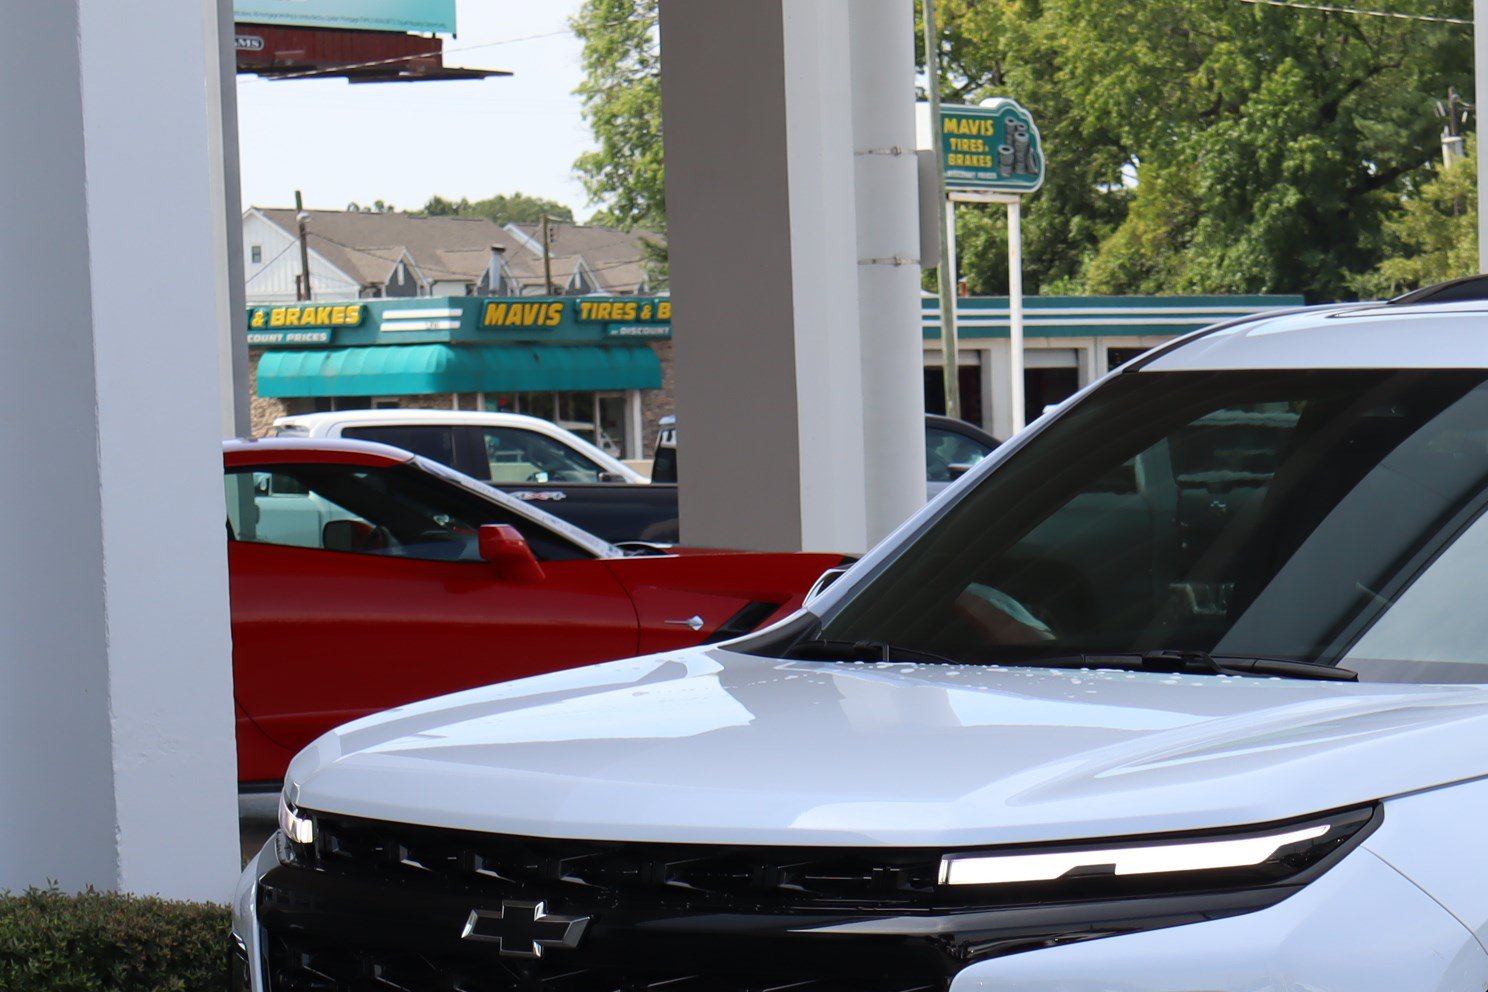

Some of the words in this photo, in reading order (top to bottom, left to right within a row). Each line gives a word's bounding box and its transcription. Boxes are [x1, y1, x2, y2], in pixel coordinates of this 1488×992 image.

[943, 118, 994, 136] MAVIS
[950, 138, 984, 152] TIRES
[948, 154, 992, 167] BRAKES
[251, 311, 265, 327] &
[270, 305, 361, 326] BRAKES
[484, 303, 563, 326] MAVIS
[580, 302, 638, 320] TIRES
[640, 305, 652, 319] &
[286, 332, 327, 342] PRICES
